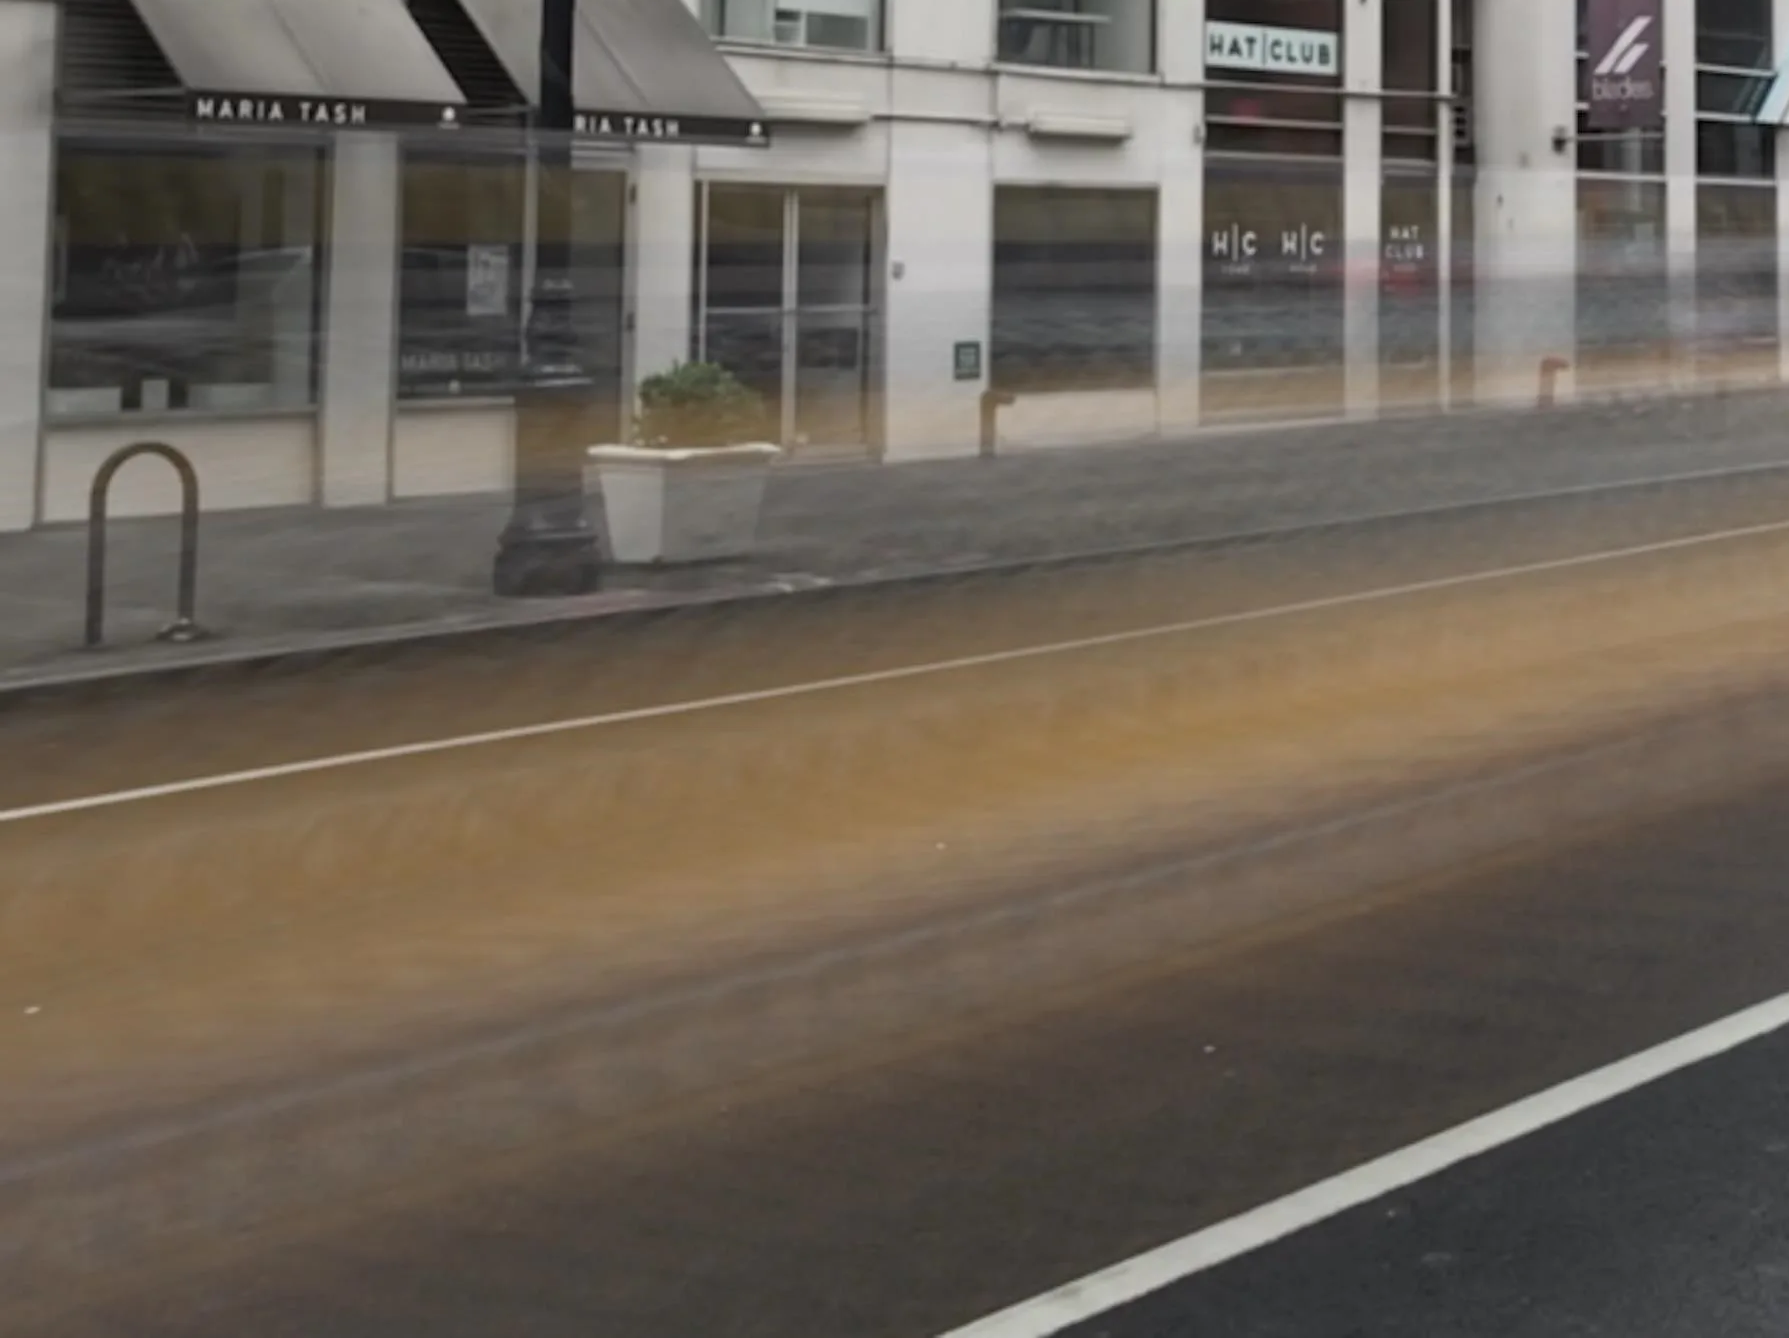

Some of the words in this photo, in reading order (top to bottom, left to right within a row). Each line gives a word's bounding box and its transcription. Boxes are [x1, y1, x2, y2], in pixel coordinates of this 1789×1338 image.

[197, 98, 284, 121] MARIA
[299, 101, 365, 124] TASH
[624, 116, 679, 137] TASH
